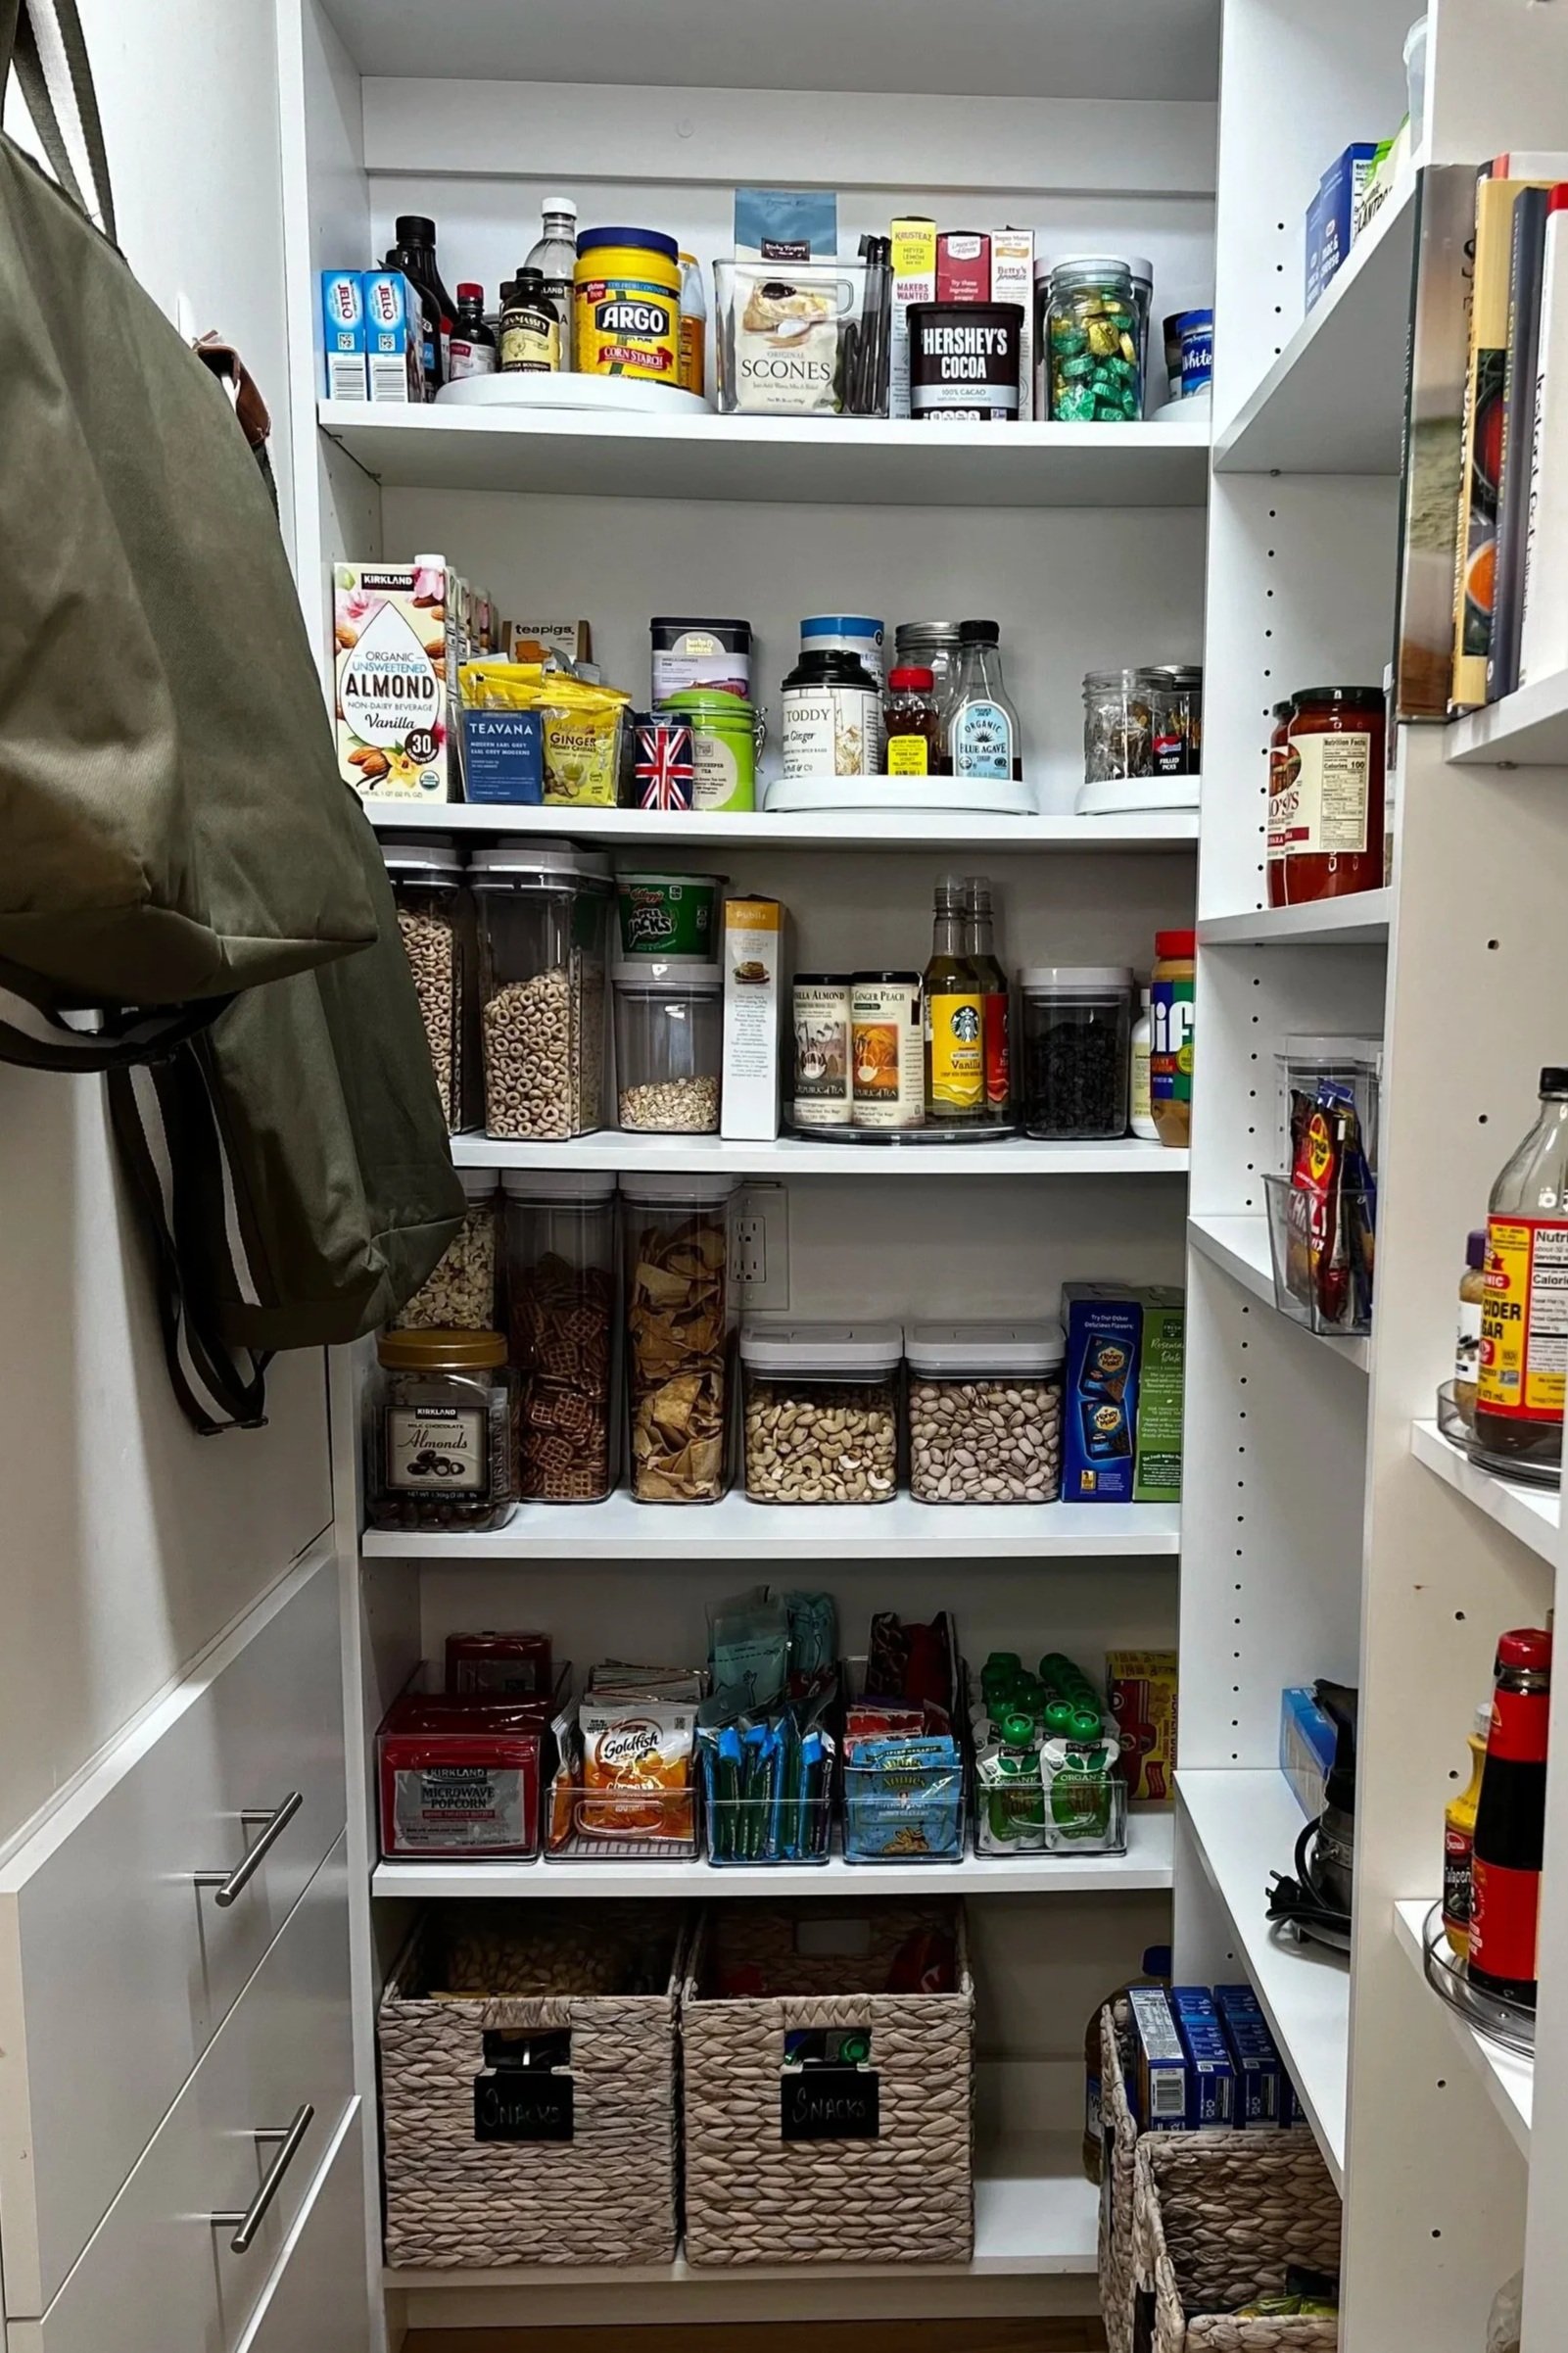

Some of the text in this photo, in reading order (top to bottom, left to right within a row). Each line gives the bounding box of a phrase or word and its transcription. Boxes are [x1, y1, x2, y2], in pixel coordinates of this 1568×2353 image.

[895, 232, 932, 242] KRUSTEAZ
[997, 266, 1027, 276] Betty's
[541, 286, 564, 295] LAND
[897, 283, 928, 292] MAKERS
[338, 284, 354, 320] JELL-O
[378, 284, 394, 320] JELL-O
[897, 292, 929, 301] WANTED
[602, 306, 664, 333] ARGO
[923, 327, 1008, 356] HERSHEY'S
[604, 347, 663, 366] CORN STARCH
[741, 360, 831, 380] SCONES
[941, 356, 987, 379] COCOA
[363, 575, 413, 586] KIRKLAND
[365, 650, 415, 661] ORGANIC
[353, 662, 427, 673] UNSWEETENED
[345, 673, 435, 699] ALMOND
[348, 701, 433, 712] NON-DAIRY BEVERAGE
[364, 713, 415, 729] Vanilla
[786, 708, 832, 723] TODDY
[469, 723, 533, 736] TEAVANA
[965, 720, 1002, 734] ORGANIC
[411, 734, 431, 753] 30
[550, 732, 596, 747] GINGER
[790, 730, 816, 744] Ginger
[960, 743, 1007, 754] BLUE AGAVE
[1351, 760, 1365, 769] 100
[813, 989, 845, 1001] ALMOND
[854, 990, 905, 1001] GINGER PEACH
[1536, 1230, 1568, 1245] Nutri
[1534, 1254, 1561, 1263] Serving
[1483, 1299, 1521, 1321] CIDER
[1151, 1338, 1185, 1349] Rosema
[1100, 1352, 1123, 1362] Honey
[1096, 1411, 1117, 1421] Honey
[397, 1429, 468, 1449] Almonds
[604, 1730, 660, 1759] Goldfish
[431, 1768, 485, 1778] KIRKLAND
[422, 1786, 496, 1799] MICROWAVE
[431, 1799, 487, 1809] POPCORN
[791, 2087, 866, 2124] SNACKS
